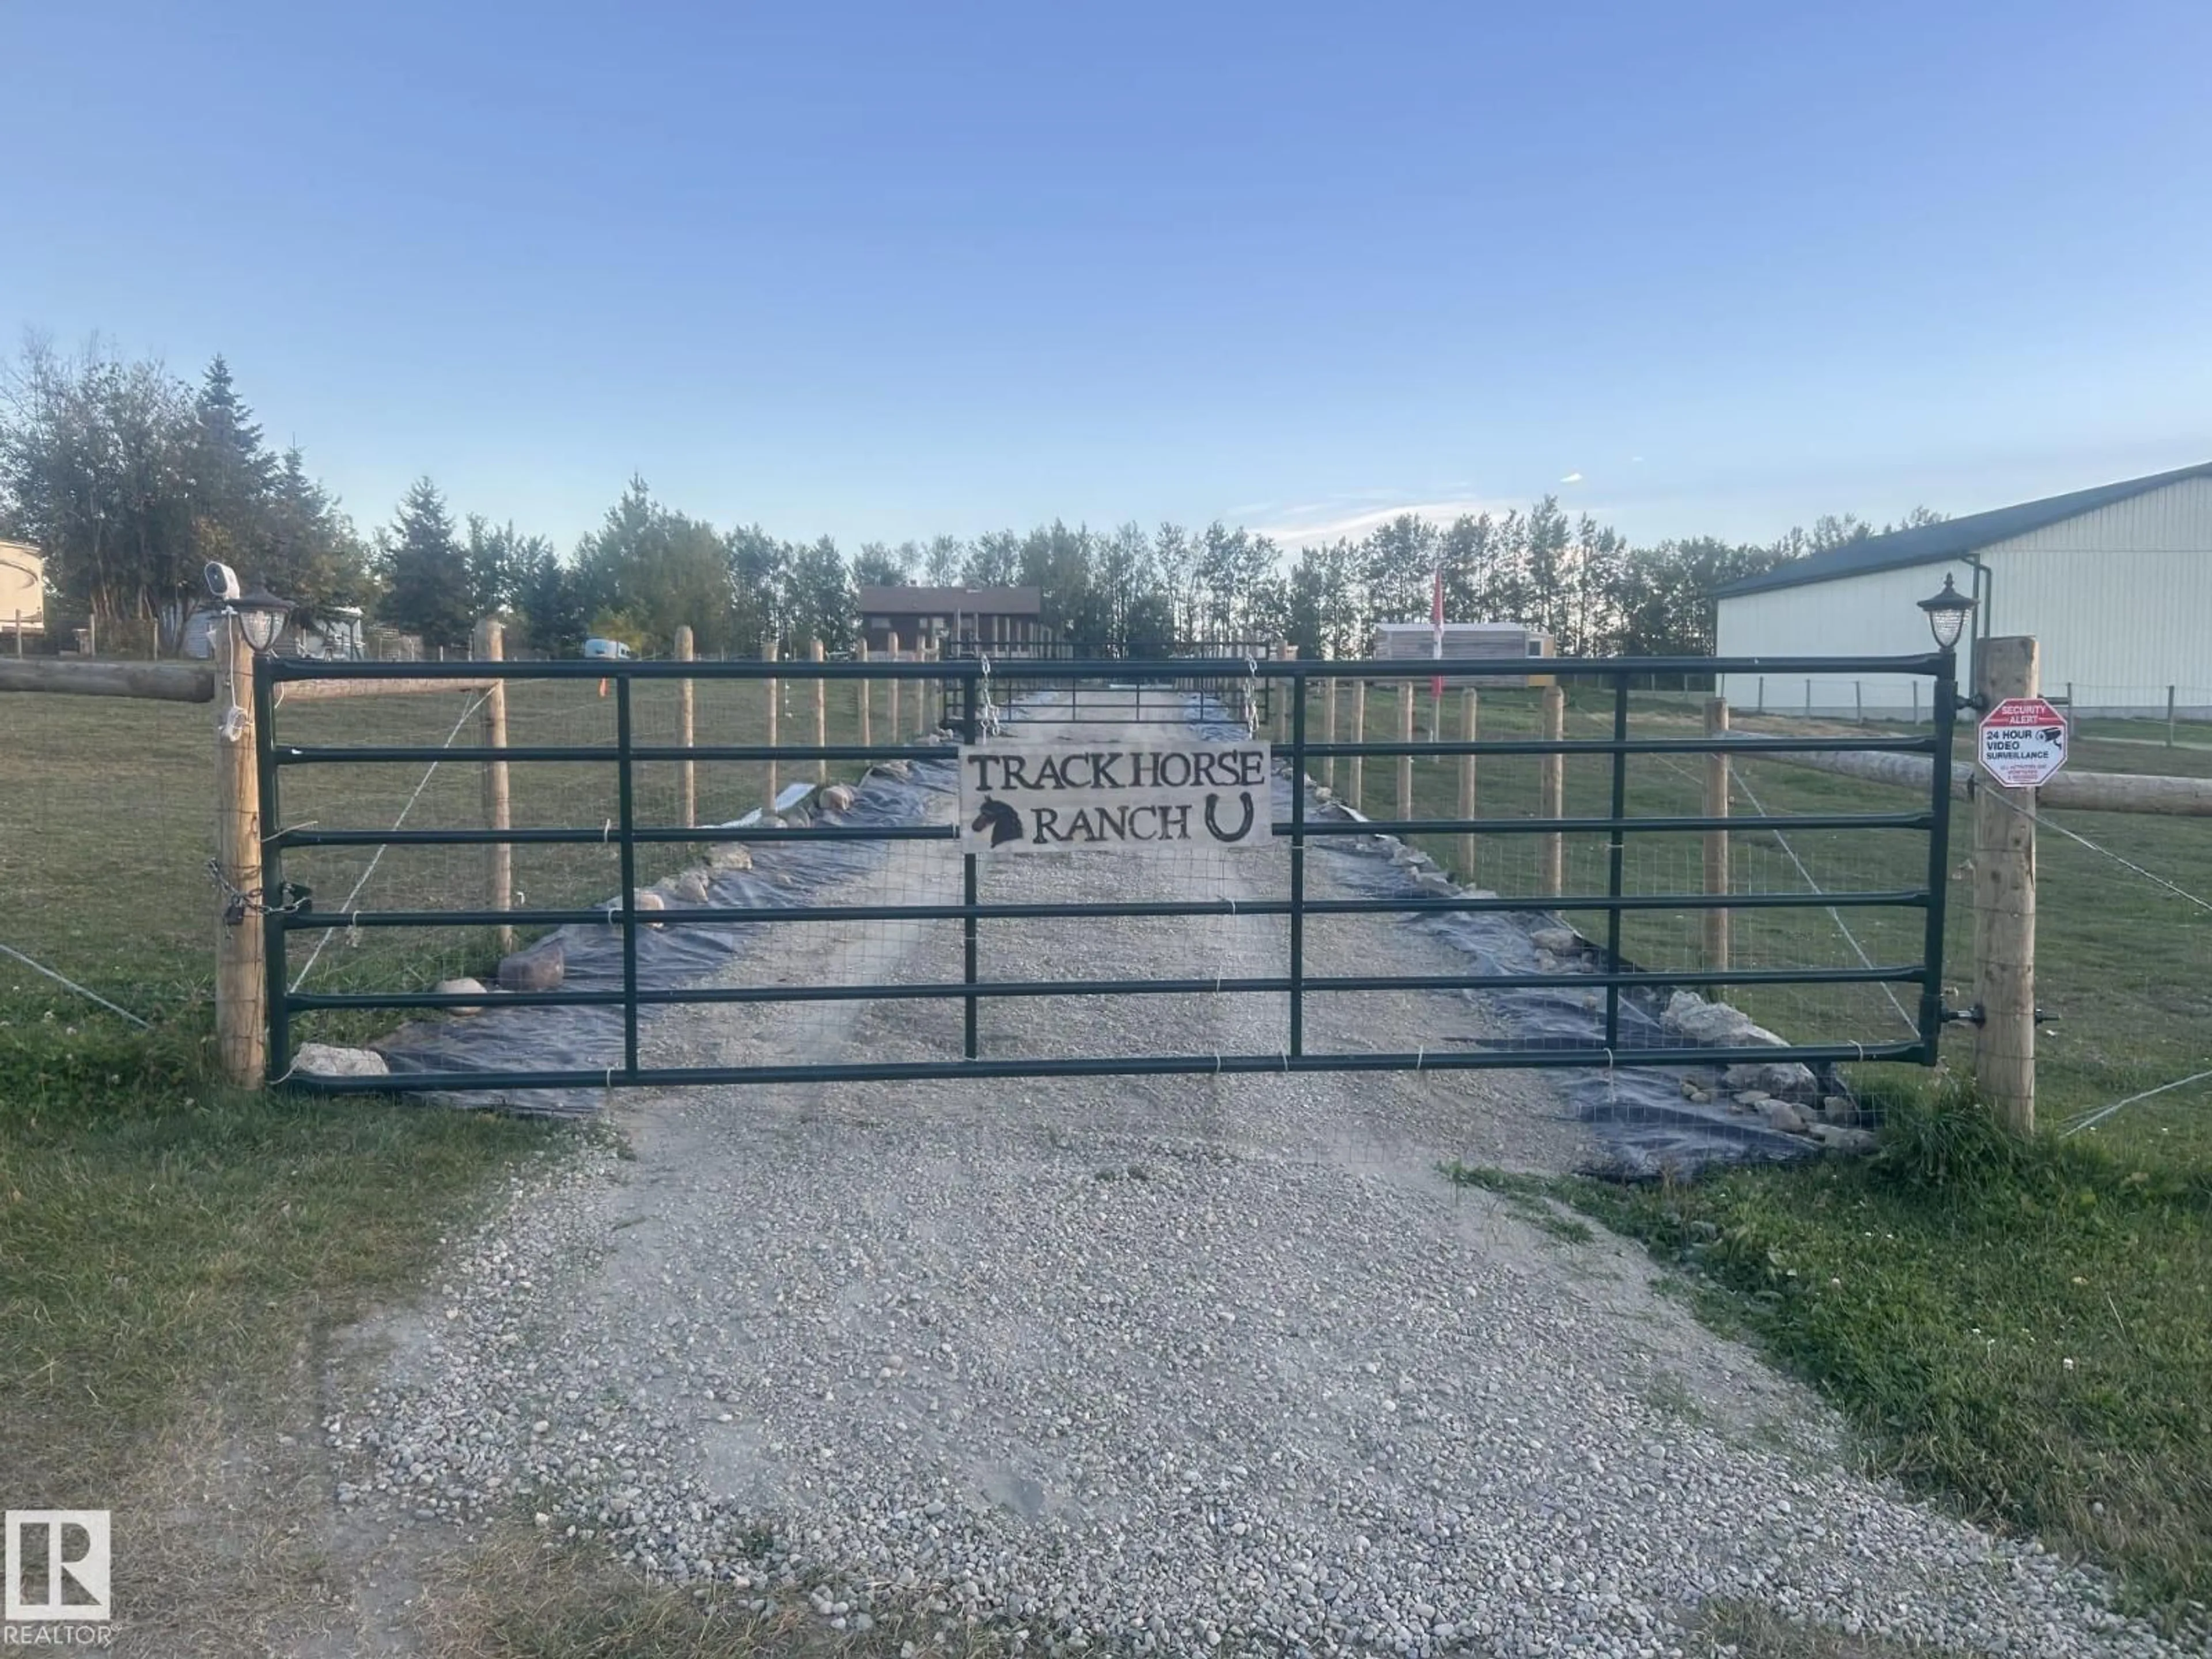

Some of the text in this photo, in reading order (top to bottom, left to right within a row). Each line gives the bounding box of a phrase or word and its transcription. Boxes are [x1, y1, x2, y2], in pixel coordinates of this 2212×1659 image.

[2002, 705, 2046, 715] SECURITY
[2009, 715, 2038, 724] ALERT
[1986, 729, 2032, 740] 24 HOUR
[1987, 741, 2020, 750] VIDEO
[1986, 751, 2050, 760] SURVEILLANCE
[1030, 805, 1192, 844] RANCH
